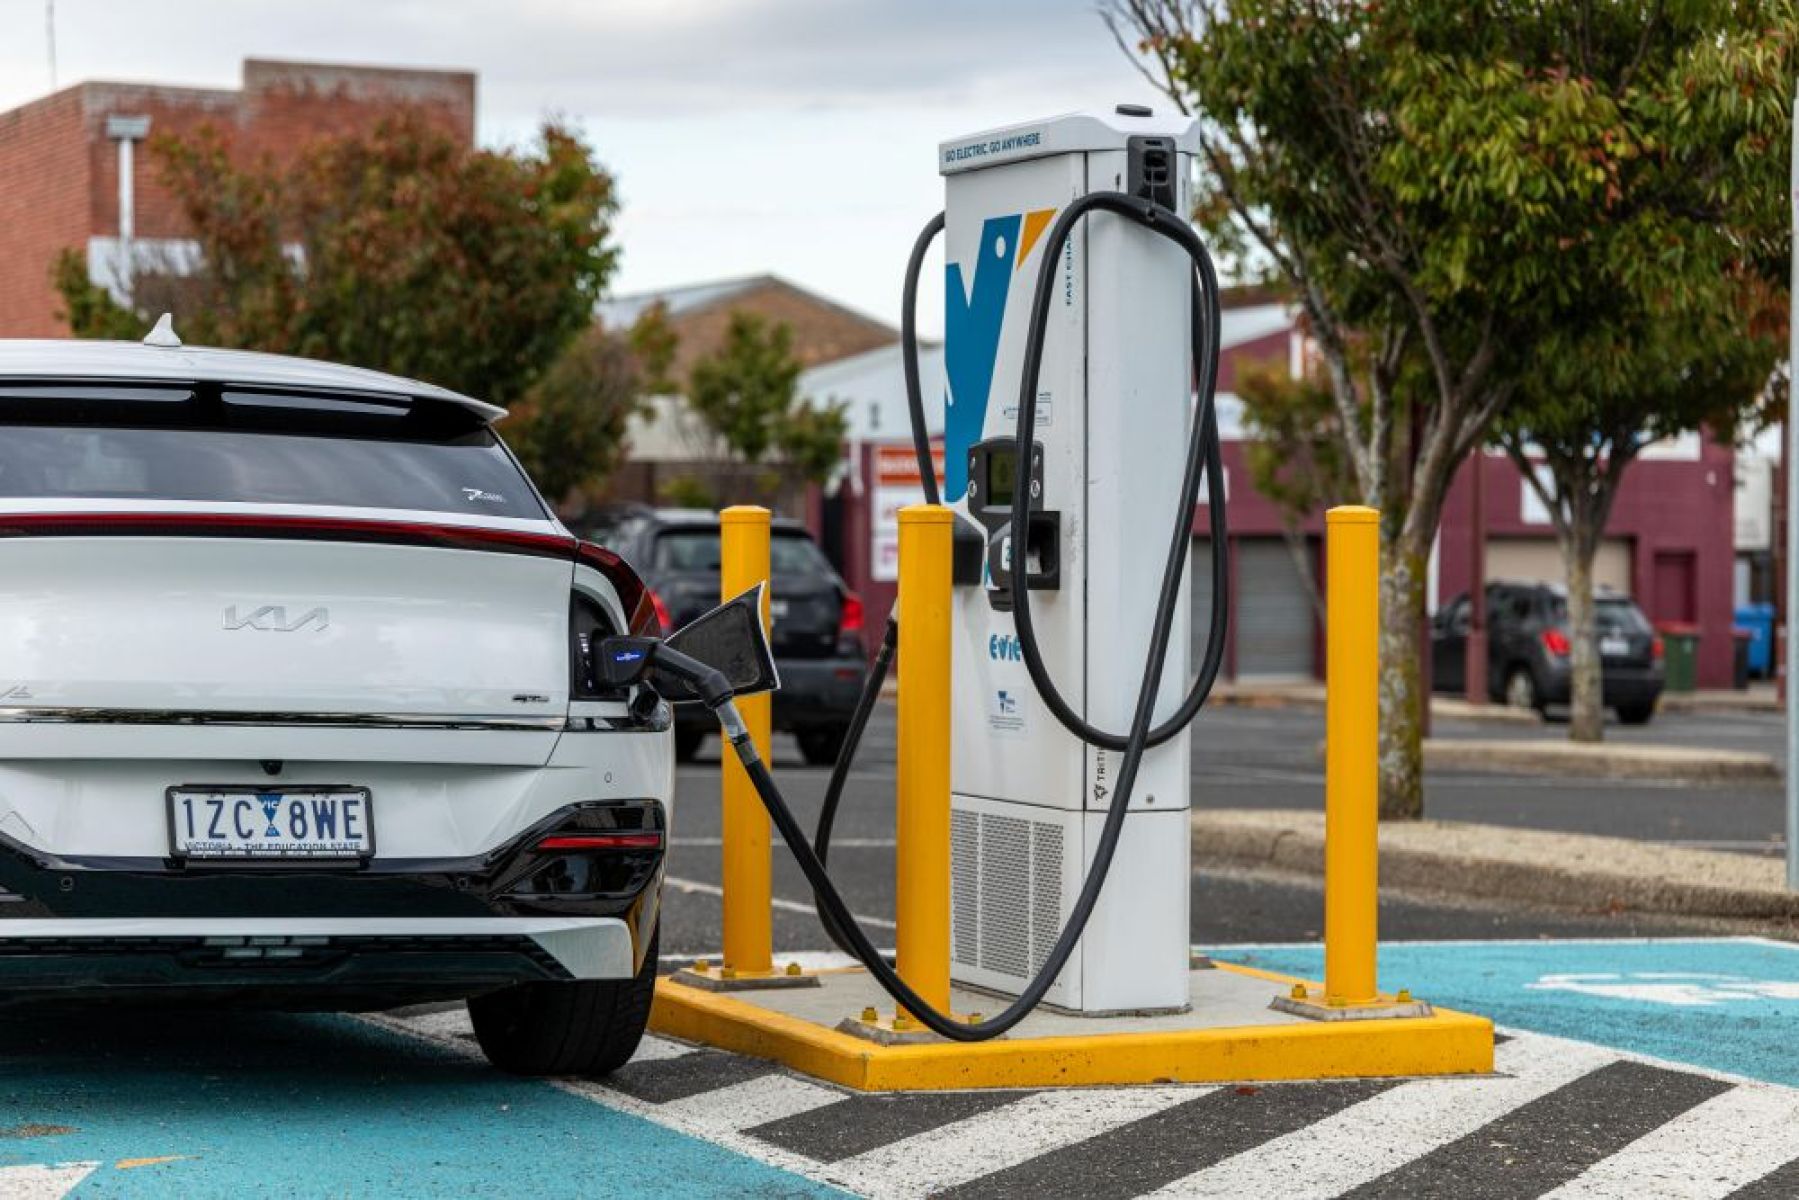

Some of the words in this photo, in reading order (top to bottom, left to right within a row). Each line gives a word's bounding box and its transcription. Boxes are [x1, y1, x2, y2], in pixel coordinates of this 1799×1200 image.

[989, 141, 1000, 154] GO
[1001, 132, 1041, 151] ANYWHERE
[182, 798, 253, 839] 1ZC
[289, 799, 362, 840] 8WE
